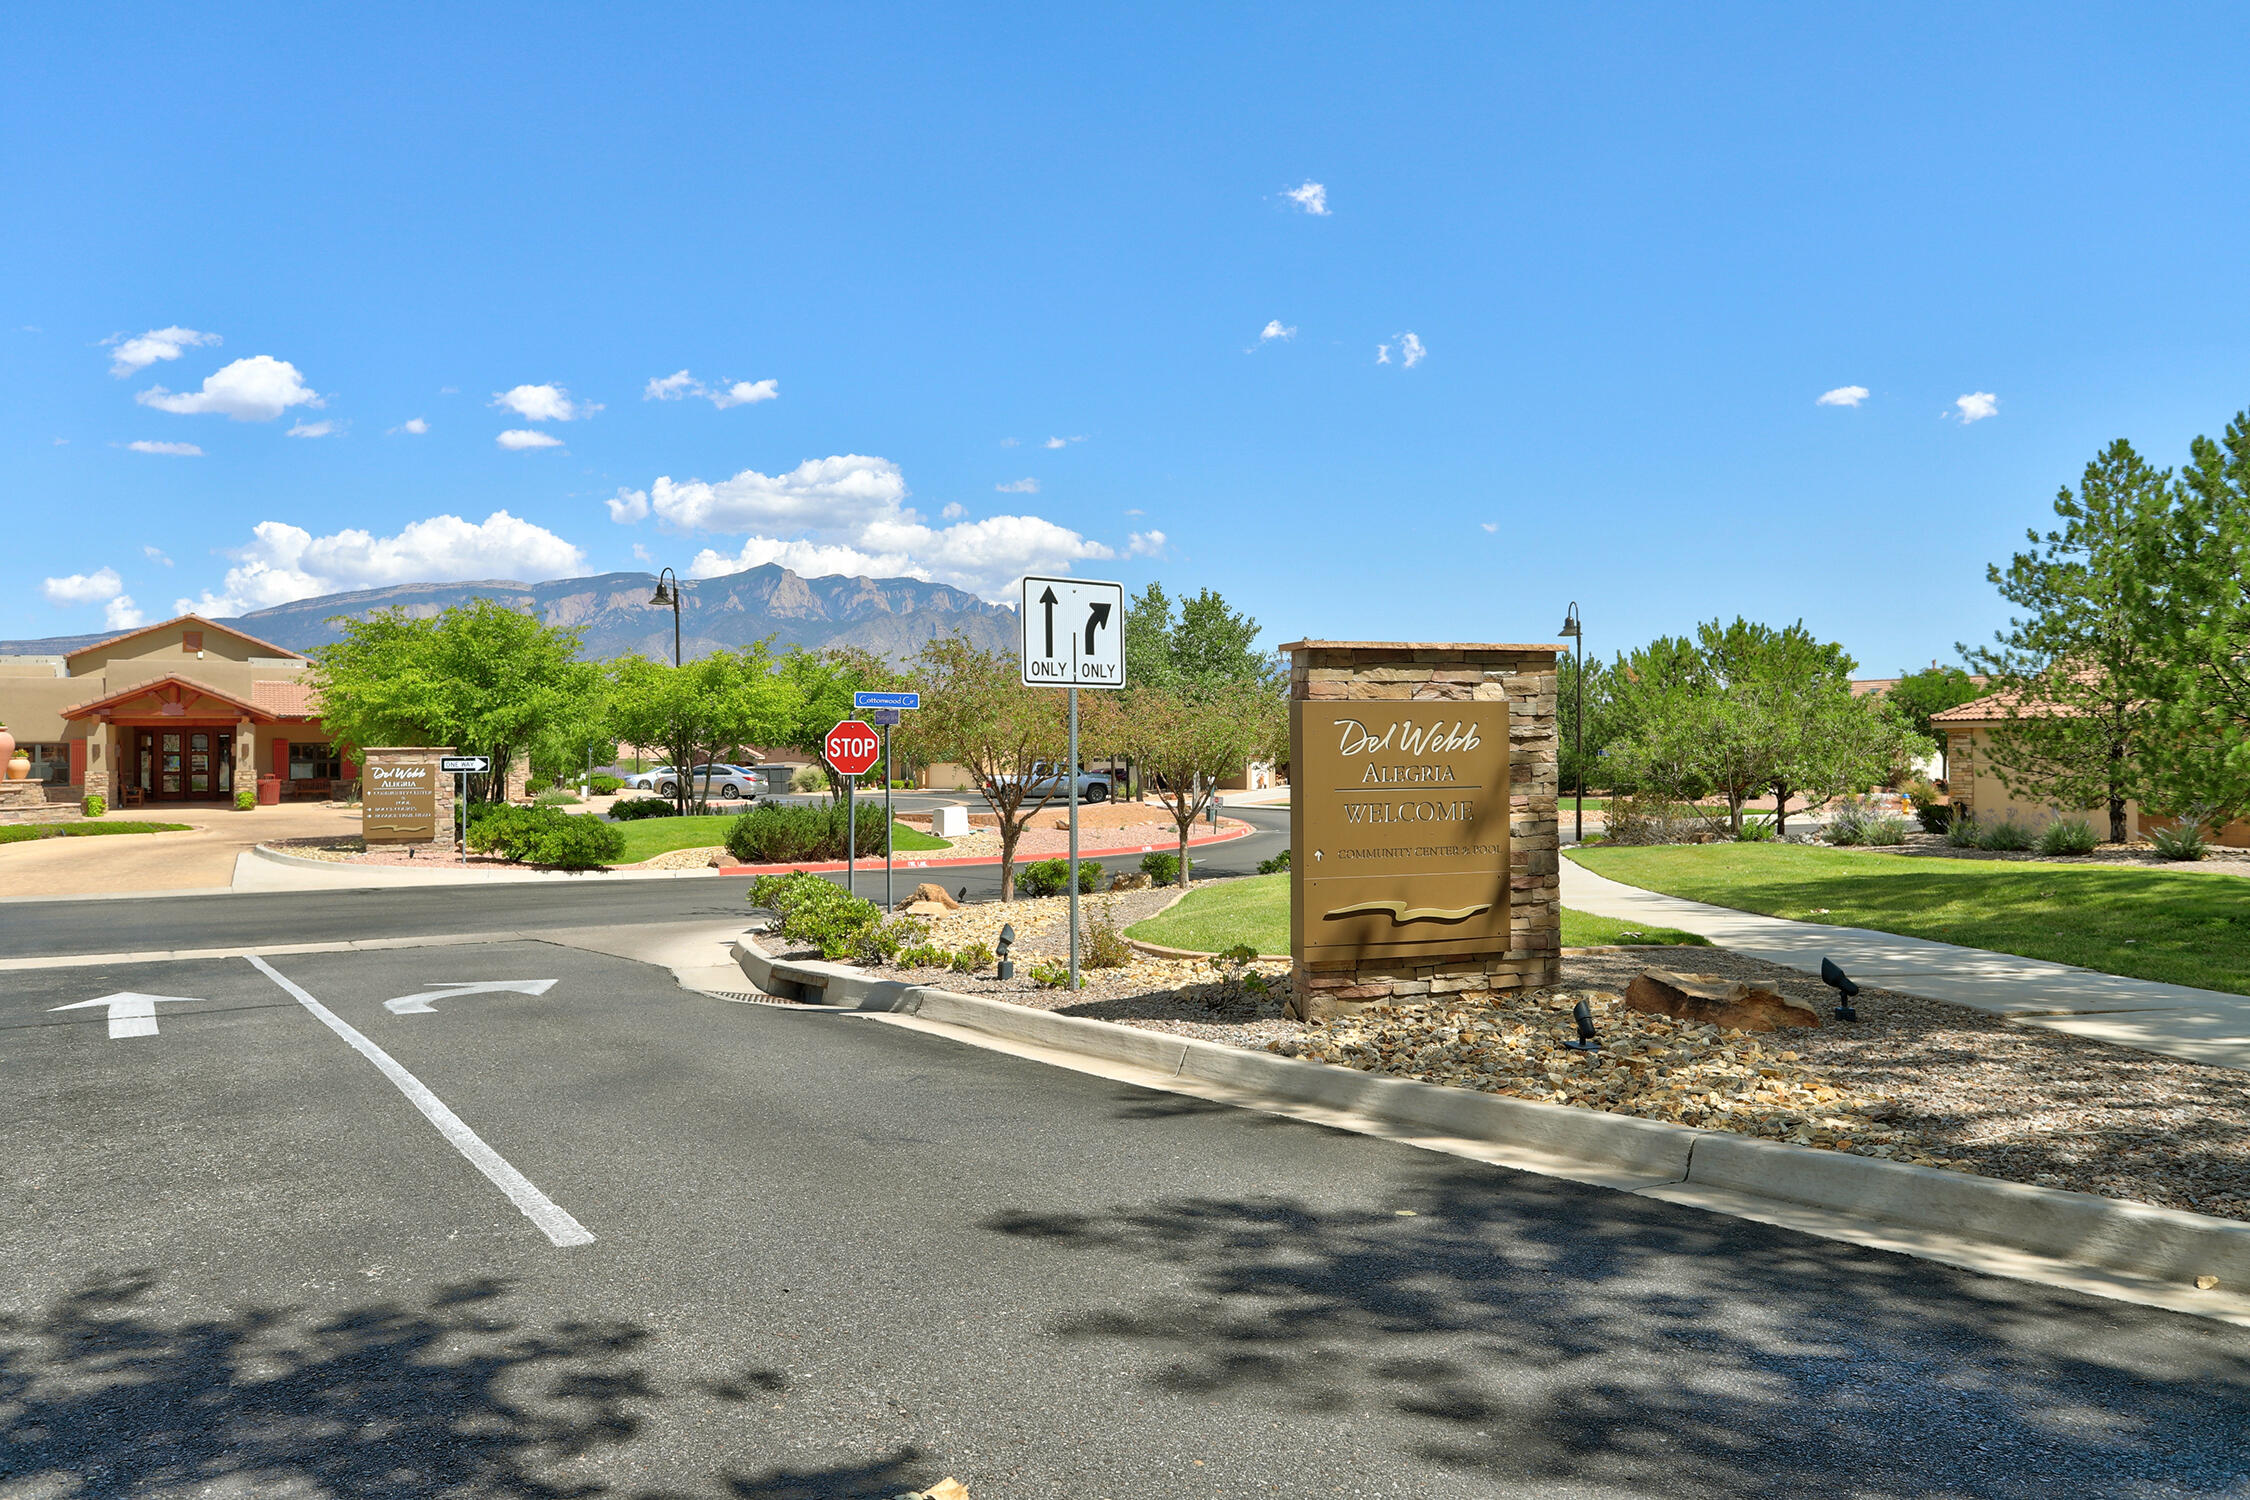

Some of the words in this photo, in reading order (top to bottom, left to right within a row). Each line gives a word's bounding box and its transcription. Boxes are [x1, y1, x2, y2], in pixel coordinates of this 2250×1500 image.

[1031, 661, 1067, 677] ONLY
[1081, 663, 1115, 679] ONLY
[858, 695, 902, 705] Cottonwood
[1333, 719, 1398, 756] Del
[1400, 719, 1481, 756] Webb
[829, 738, 876, 758] STOP
[371, 767, 395, 780] Del
[395, 767, 426, 780] Webb
[1361, 762, 1456, 783] ALEGRIA
[1343, 801, 1474, 825] WELCOME
[1337, 848, 1413, 860] COMMUNITY
[1414, 846, 1459, 857] CENTER
[1460, 847, 1470, 856] &
[1472, 844, 1504, 855] POOL
